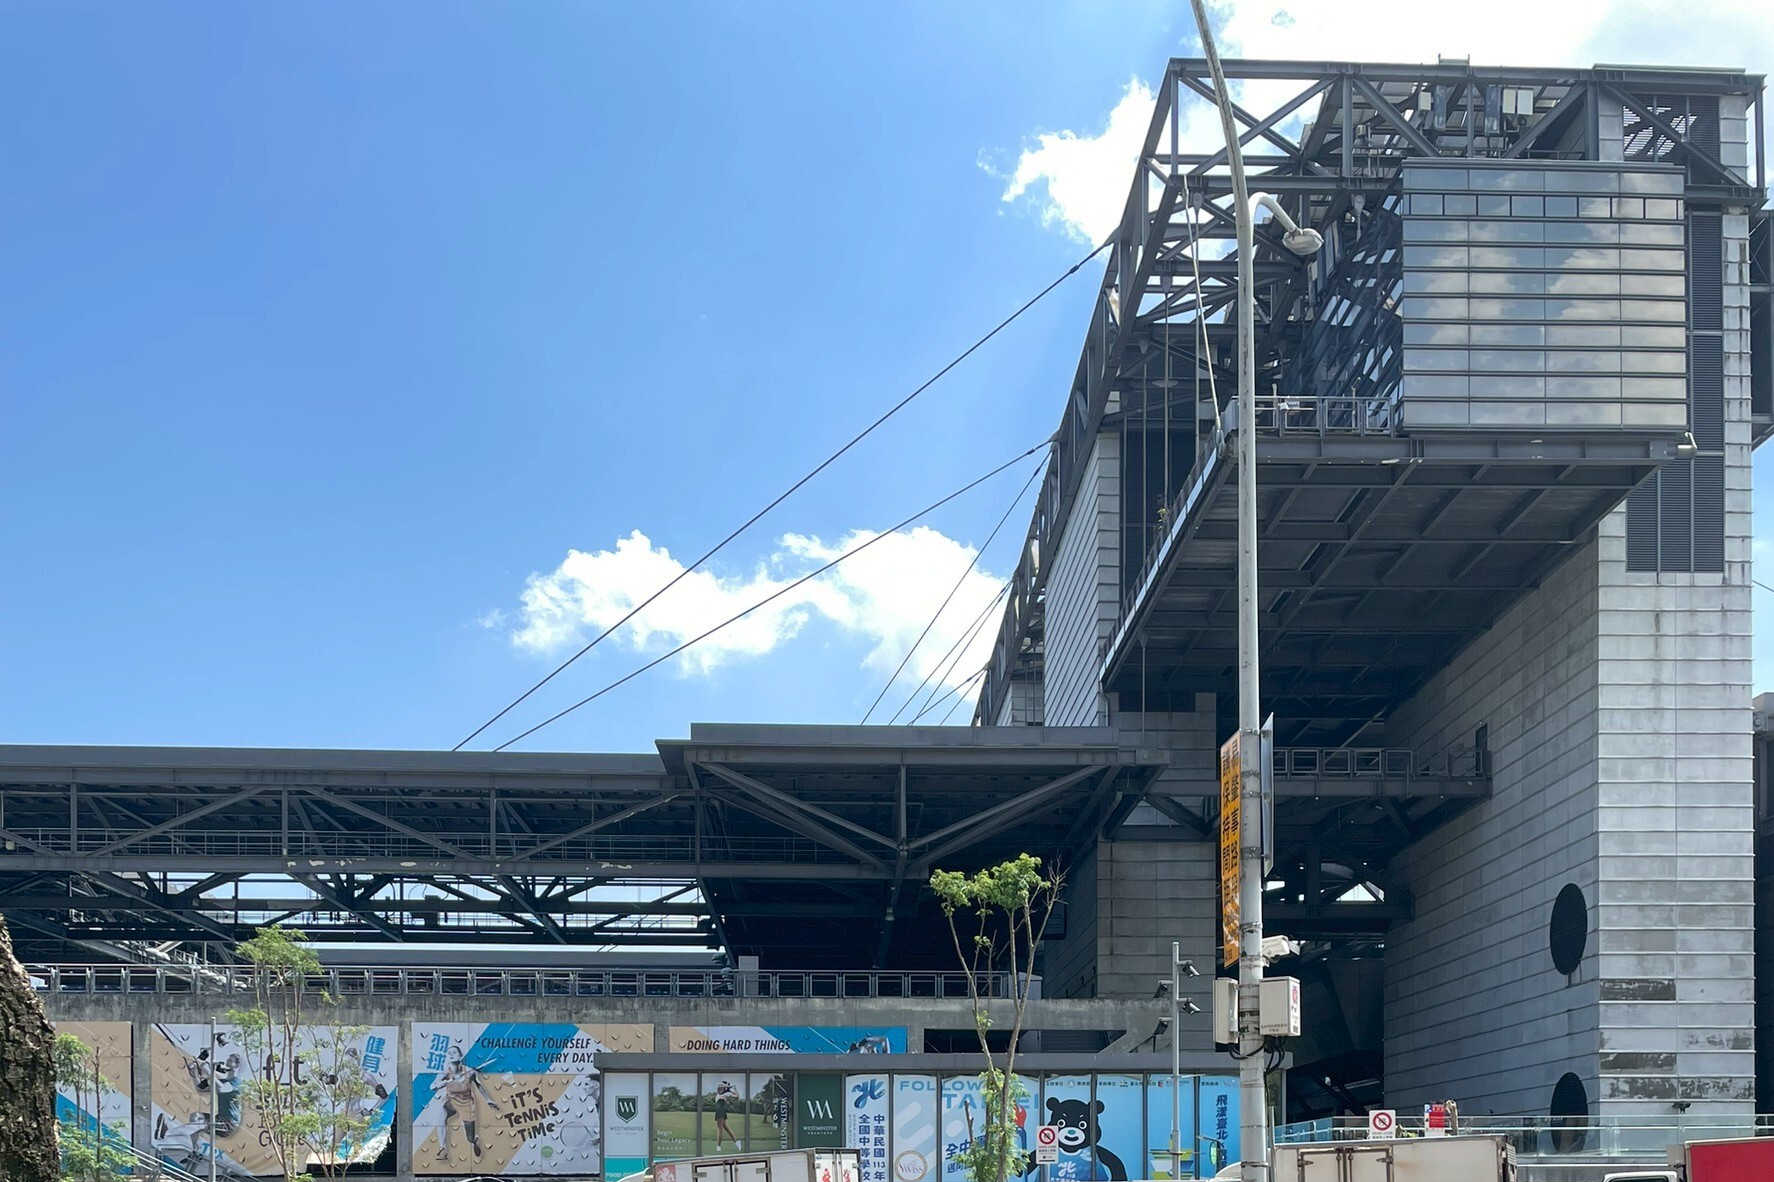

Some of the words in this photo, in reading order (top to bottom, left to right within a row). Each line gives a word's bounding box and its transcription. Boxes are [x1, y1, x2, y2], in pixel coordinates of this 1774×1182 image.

[362, 1035, 386, 1073] 健身
[426, 1033, 450, 1071] 羽球
[481, 1037, 538, 1049] CHALLENGE
[541, 1037, 592, 1049] YOURSELF
[686, 1039, 720, 1051] DOING
[722, 1039, 751, 1051] HARD
[754, 1039, 791, 1051] THINGS
[537, 1052, 569, 1064] EVERY
[572, 1052, 594, 1064] DAY.
[780, 1097, 788, 1150] WESTMINSTER
